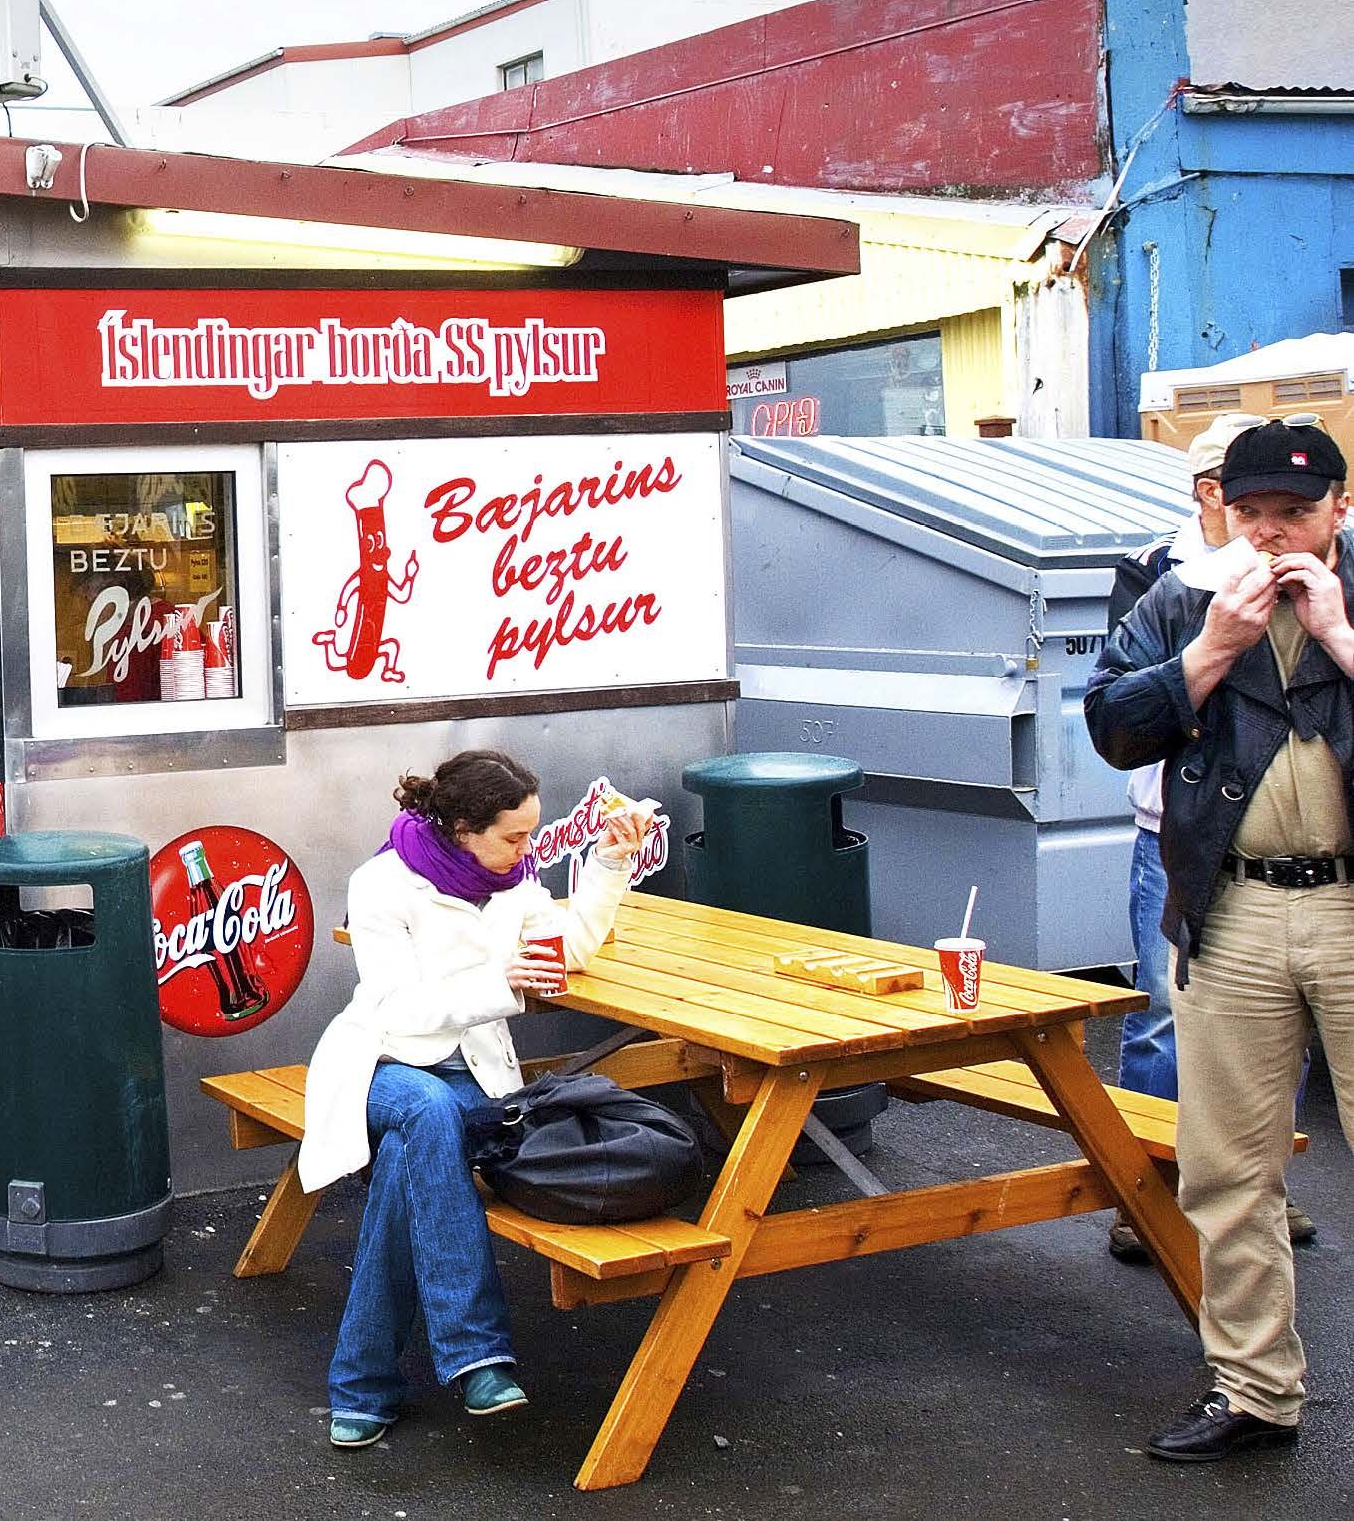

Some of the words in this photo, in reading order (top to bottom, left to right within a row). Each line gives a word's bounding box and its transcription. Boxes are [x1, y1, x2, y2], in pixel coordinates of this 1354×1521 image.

[100, 312, 316, 394] Íslendingar
[445, 322, 486, 378] SS
[494, 322, 602, 391] pylsur
[726, 382, 753, 396] ROYAL
[755, 378, 784, 393] CANIN
[424, 456, 682, 543] Bæjarins
[70, 548, 167, 573] BEZTU
[492, 532, 628, 605] beztu
[75, 586, 223, 683] Pylsur
[486, 590, 662, 680] pylsur
[153, 857, 296, 985] oca-Cola
